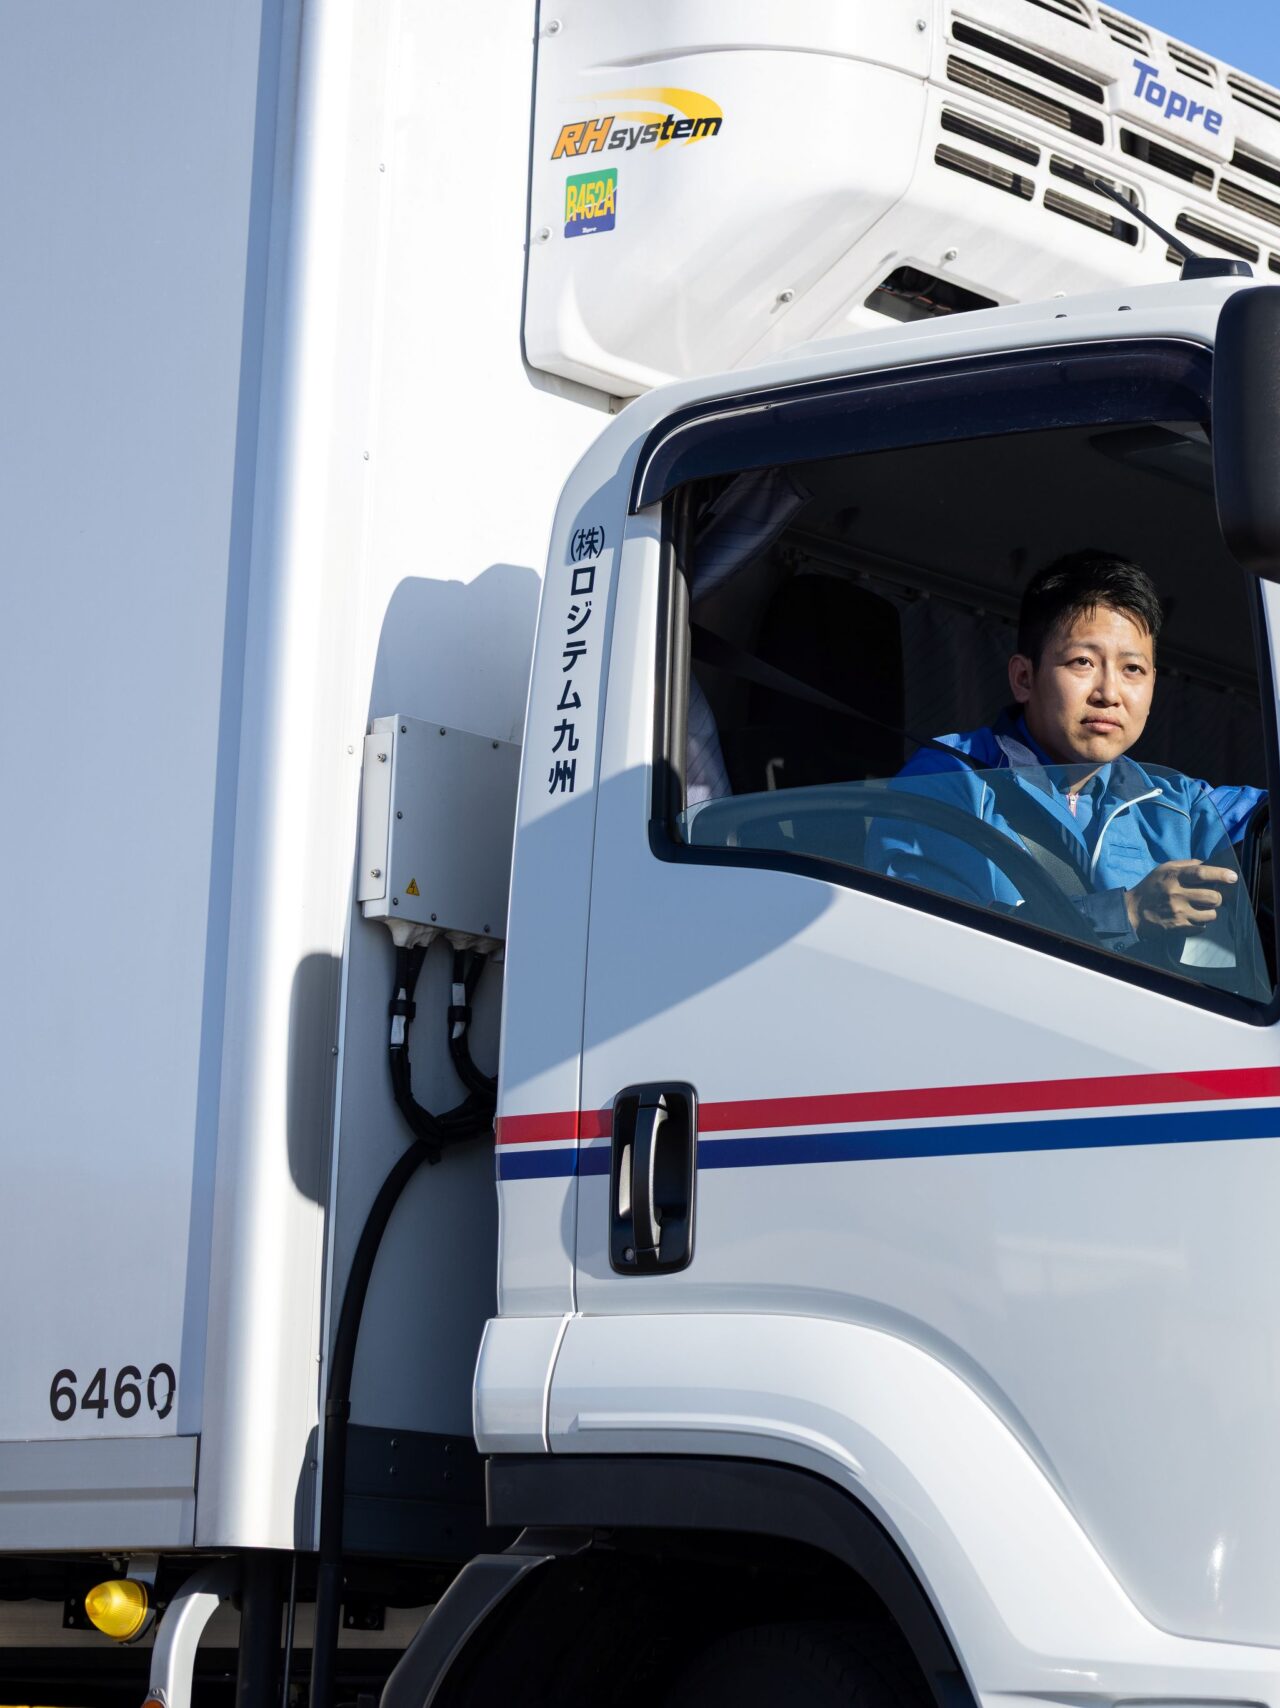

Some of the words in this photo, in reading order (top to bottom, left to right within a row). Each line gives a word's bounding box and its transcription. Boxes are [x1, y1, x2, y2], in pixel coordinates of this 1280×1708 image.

[1133, 58, 1223, 135] Topre
[566, 178, 615, 222] R452A
[49, 1361, 177, 1422] 6460
